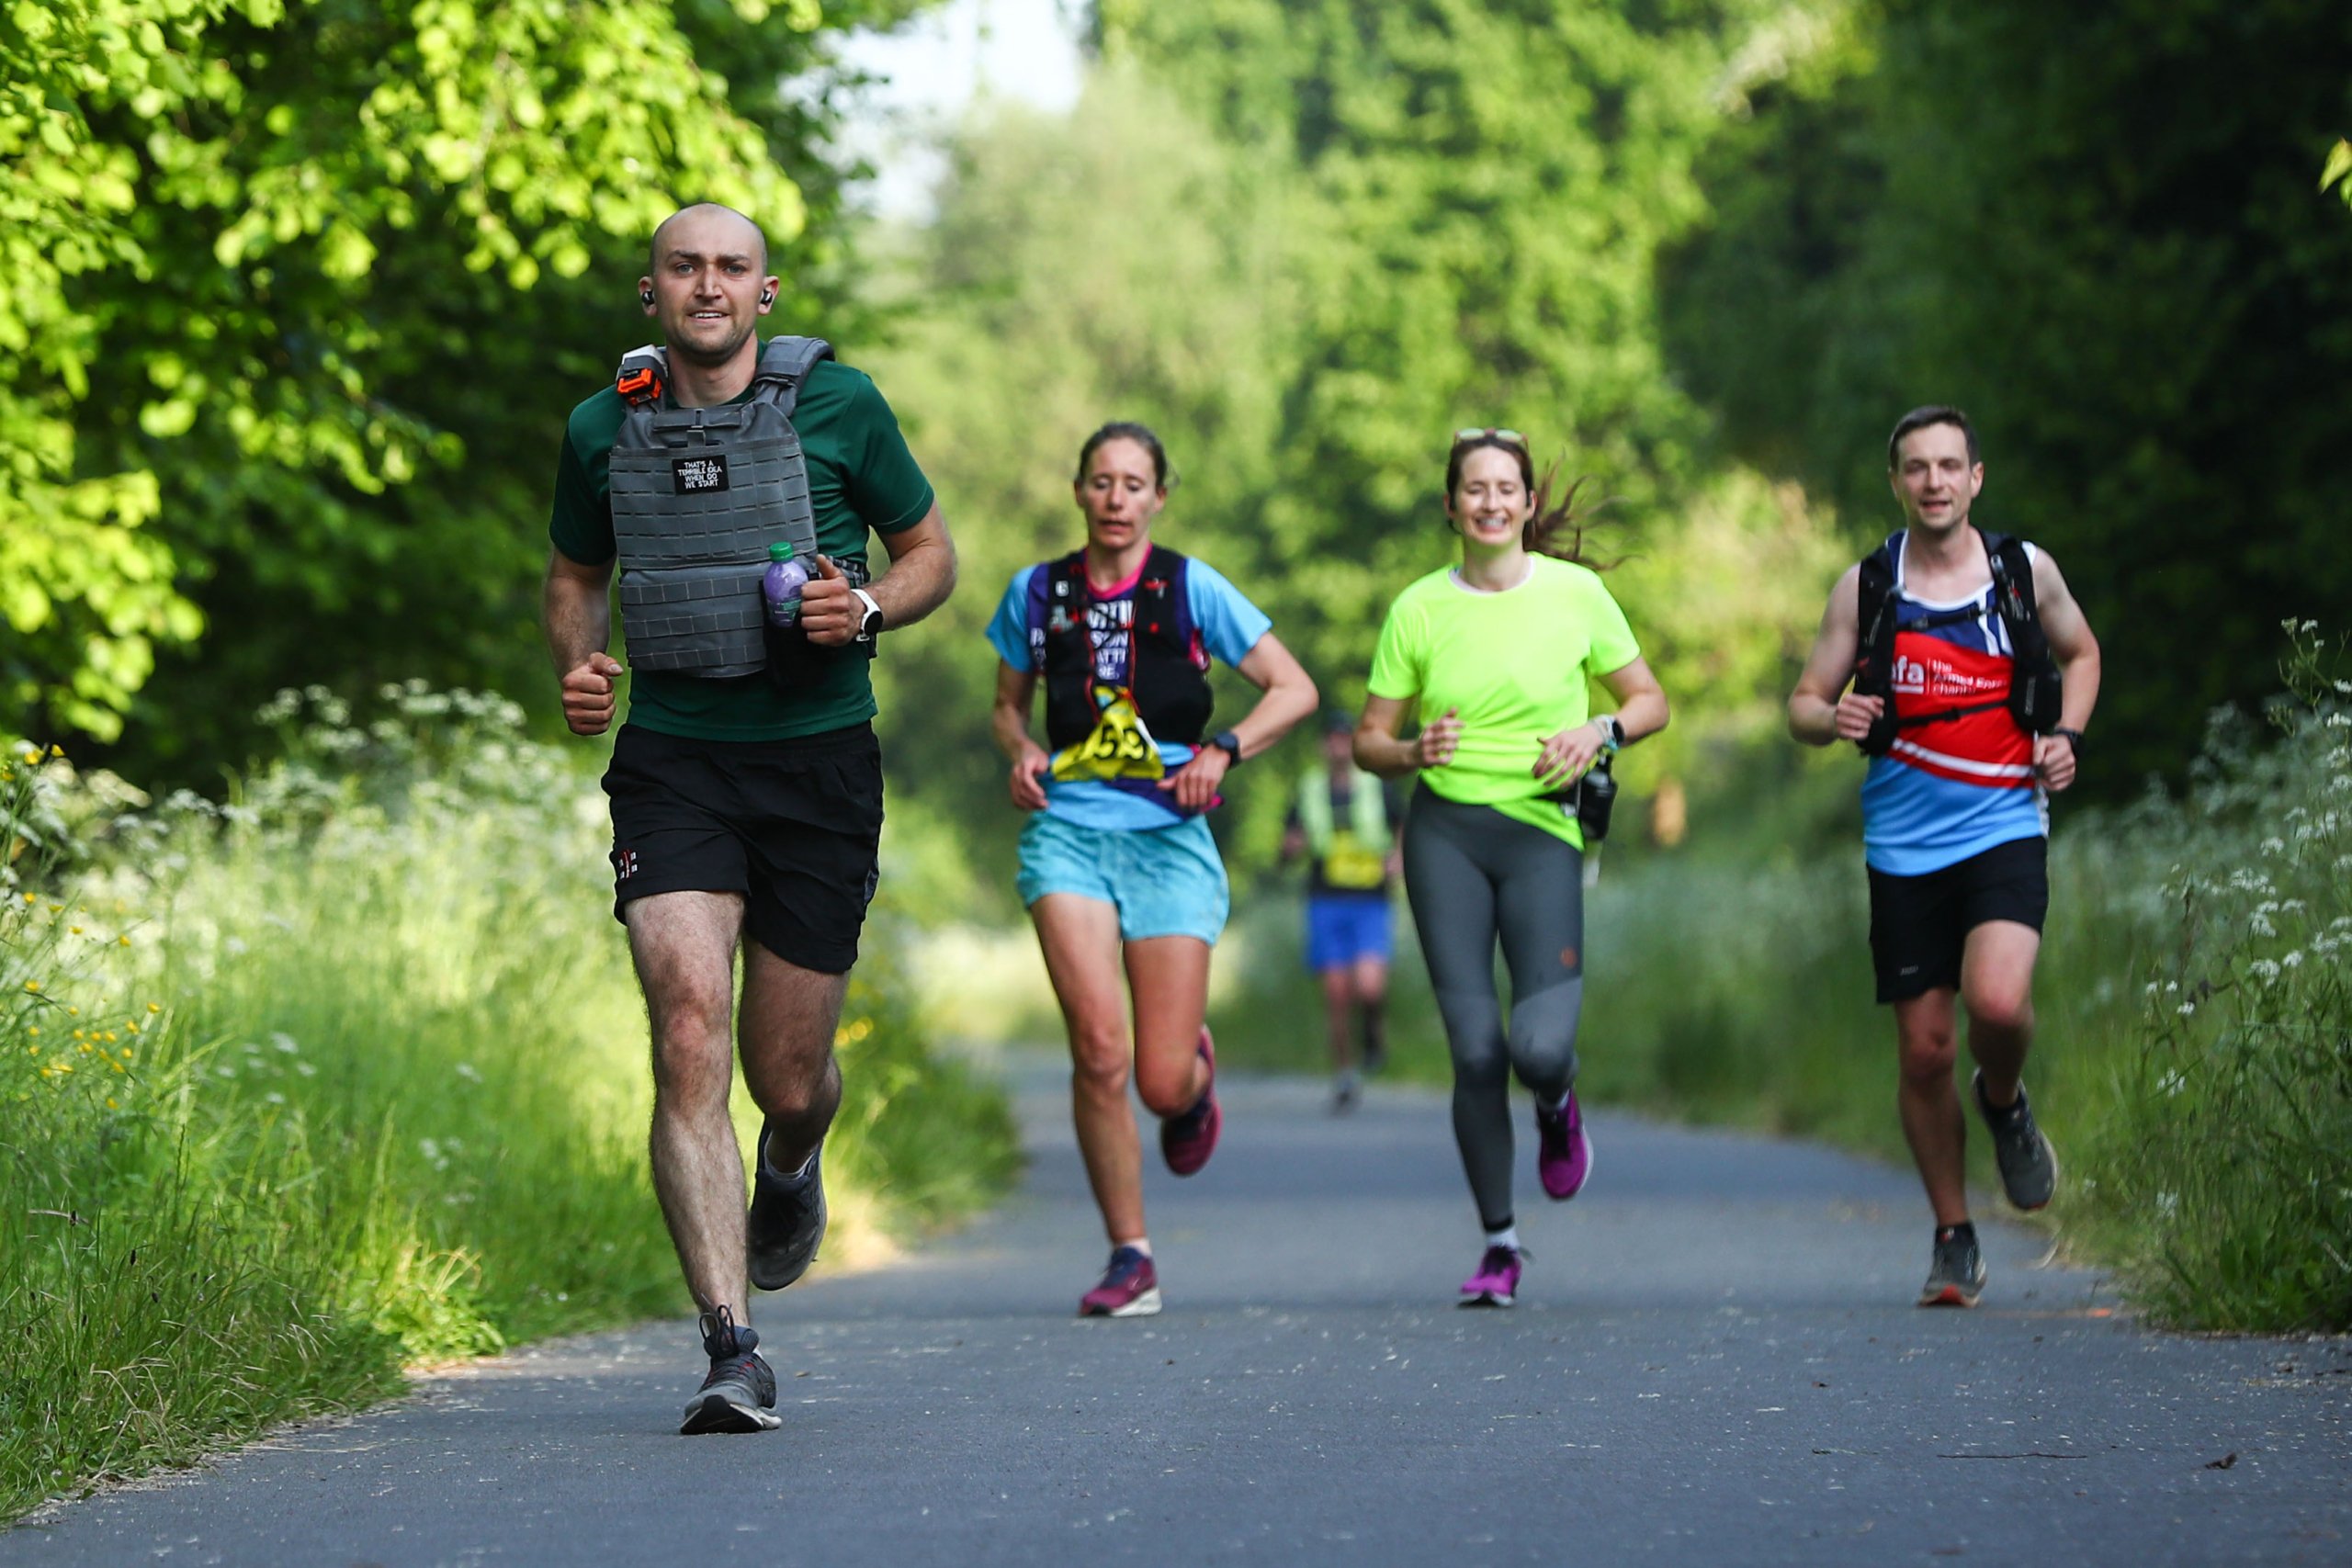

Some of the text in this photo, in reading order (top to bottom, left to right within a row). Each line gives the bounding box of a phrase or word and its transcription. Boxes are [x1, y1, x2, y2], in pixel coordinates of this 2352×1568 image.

[677, 465, 723, 477] TERRIBLE IDEA
[684, 472, 718, 482] WHEN DO
[684, 479, 718, 490] WE START
